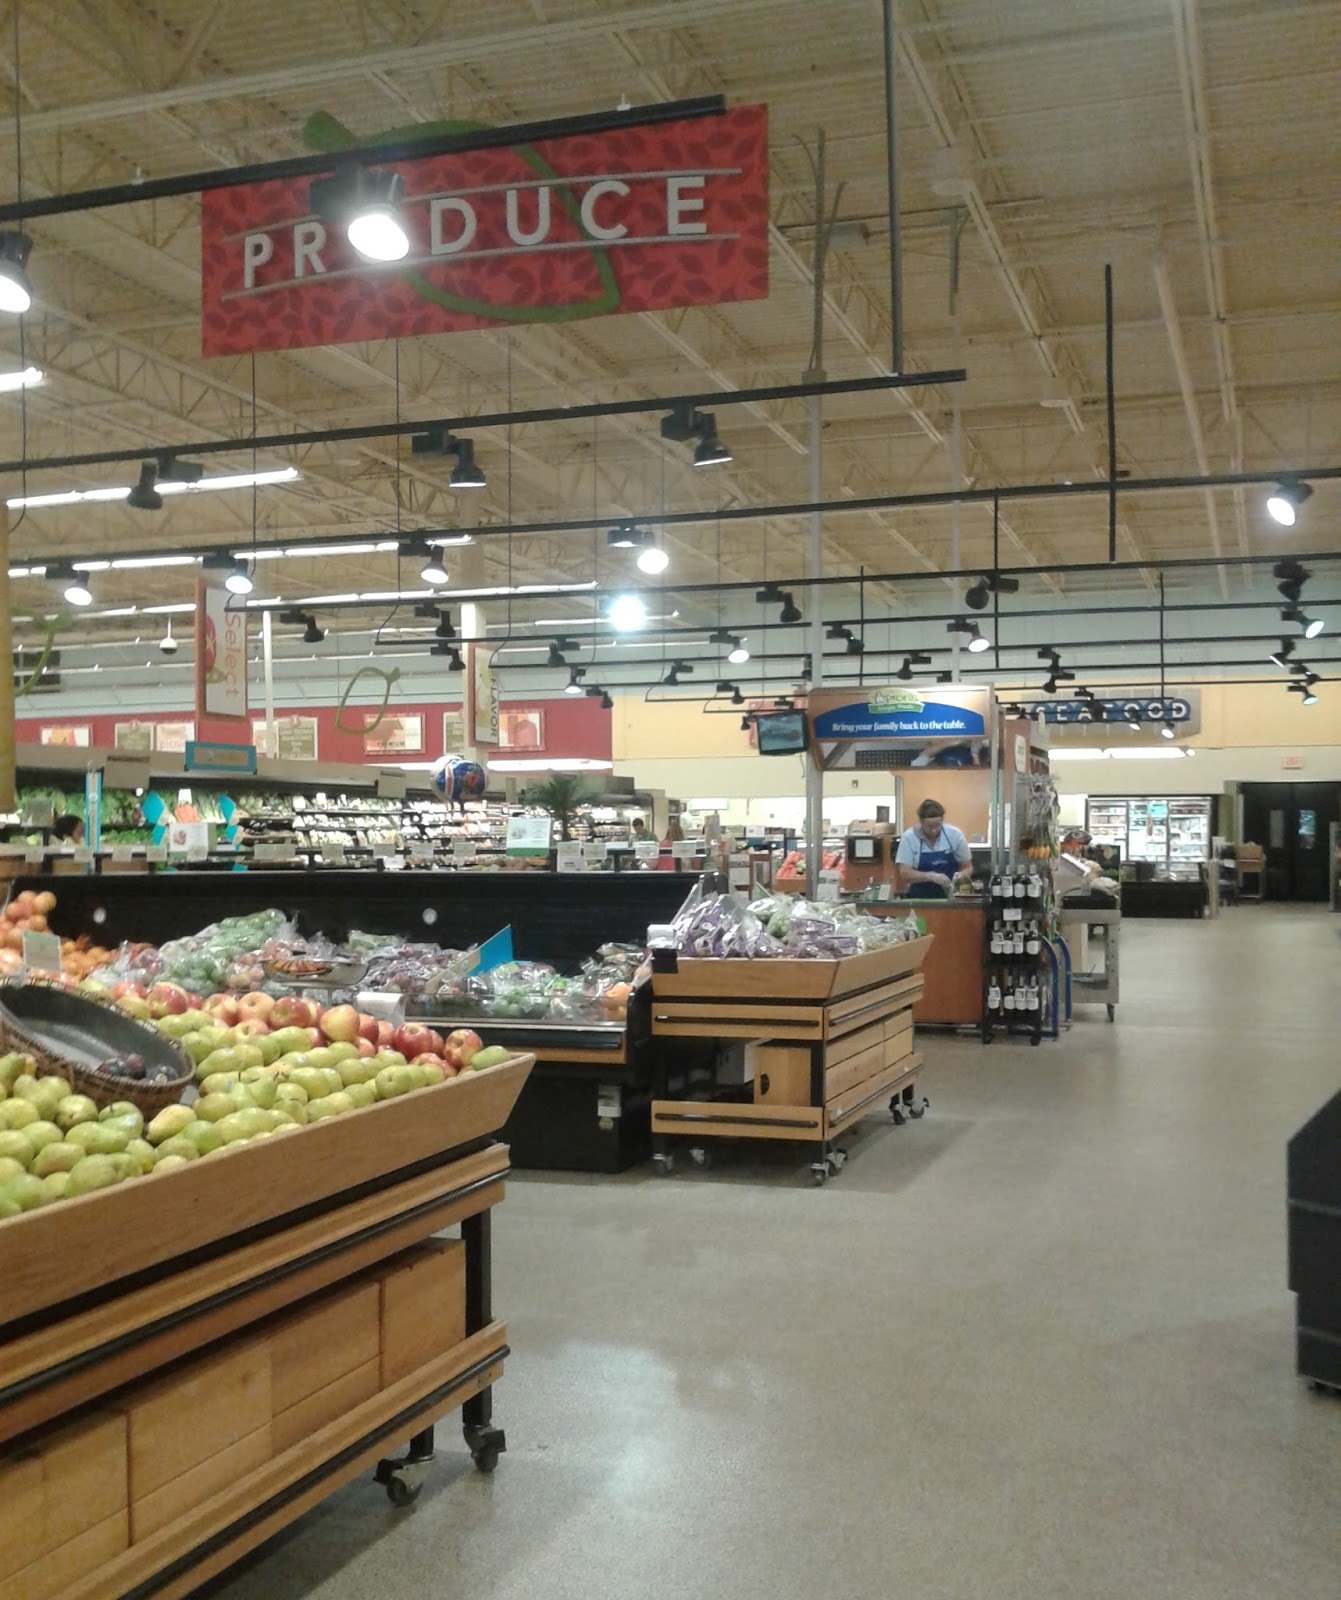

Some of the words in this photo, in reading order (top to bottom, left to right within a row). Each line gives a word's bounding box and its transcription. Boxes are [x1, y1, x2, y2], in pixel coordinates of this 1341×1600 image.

[243, 175, 707, 289] PRDUCE
[224, 611, 241, 698] Select
[832, 722, 854, 733] Bring
[854, 724, 873, 733] your
[873, 721, 899, 733] family
[899, 721, 919, 731] back
[920, 721, 929, 730] to
[929, 720, 943, 730] the
